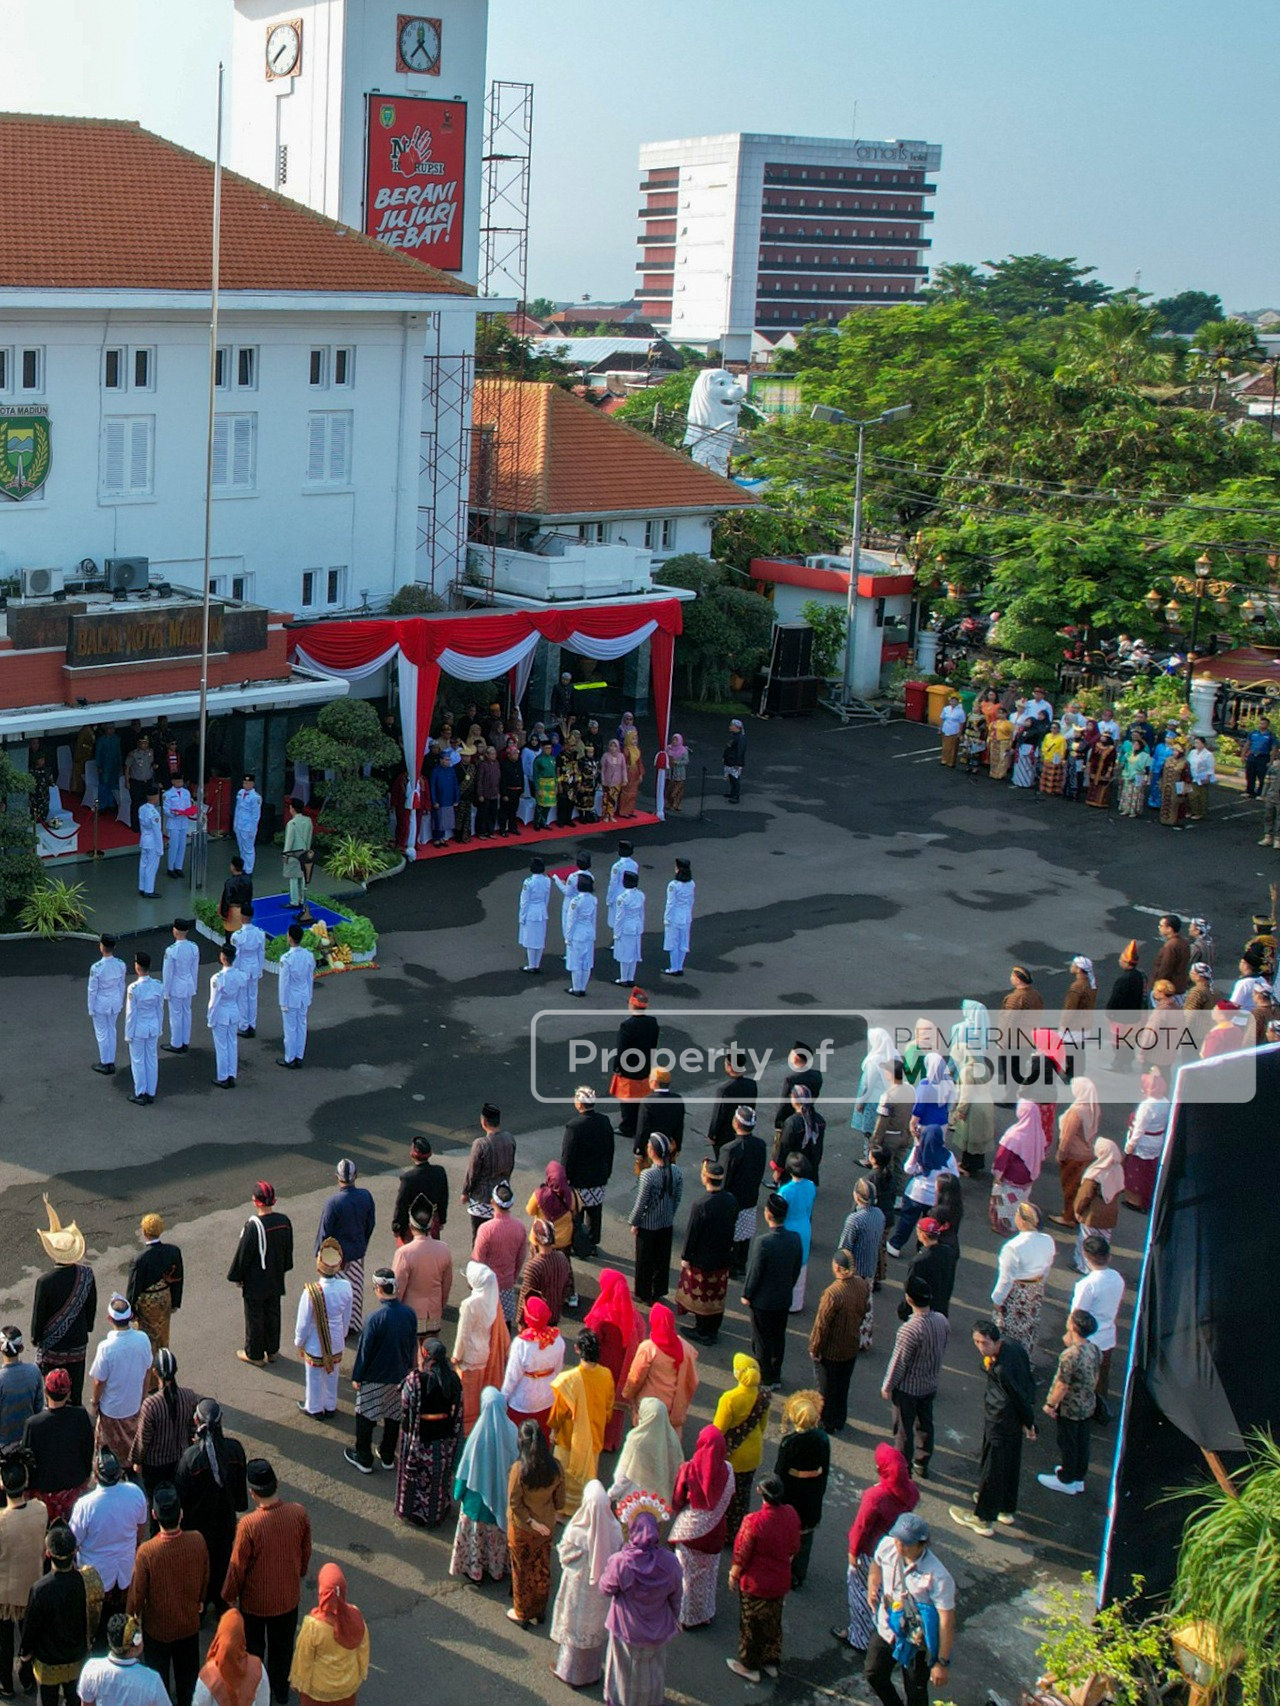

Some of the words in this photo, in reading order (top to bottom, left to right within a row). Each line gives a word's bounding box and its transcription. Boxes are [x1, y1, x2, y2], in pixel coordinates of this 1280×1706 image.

[374, 181, 457, 210] BERANI
[376, 202, 450, 232] JUJUR
[17, 406, 48, 415] MADIUN
[78, 625, 120, 655] BALAI
[125, 621, 164, 650] KOTA
